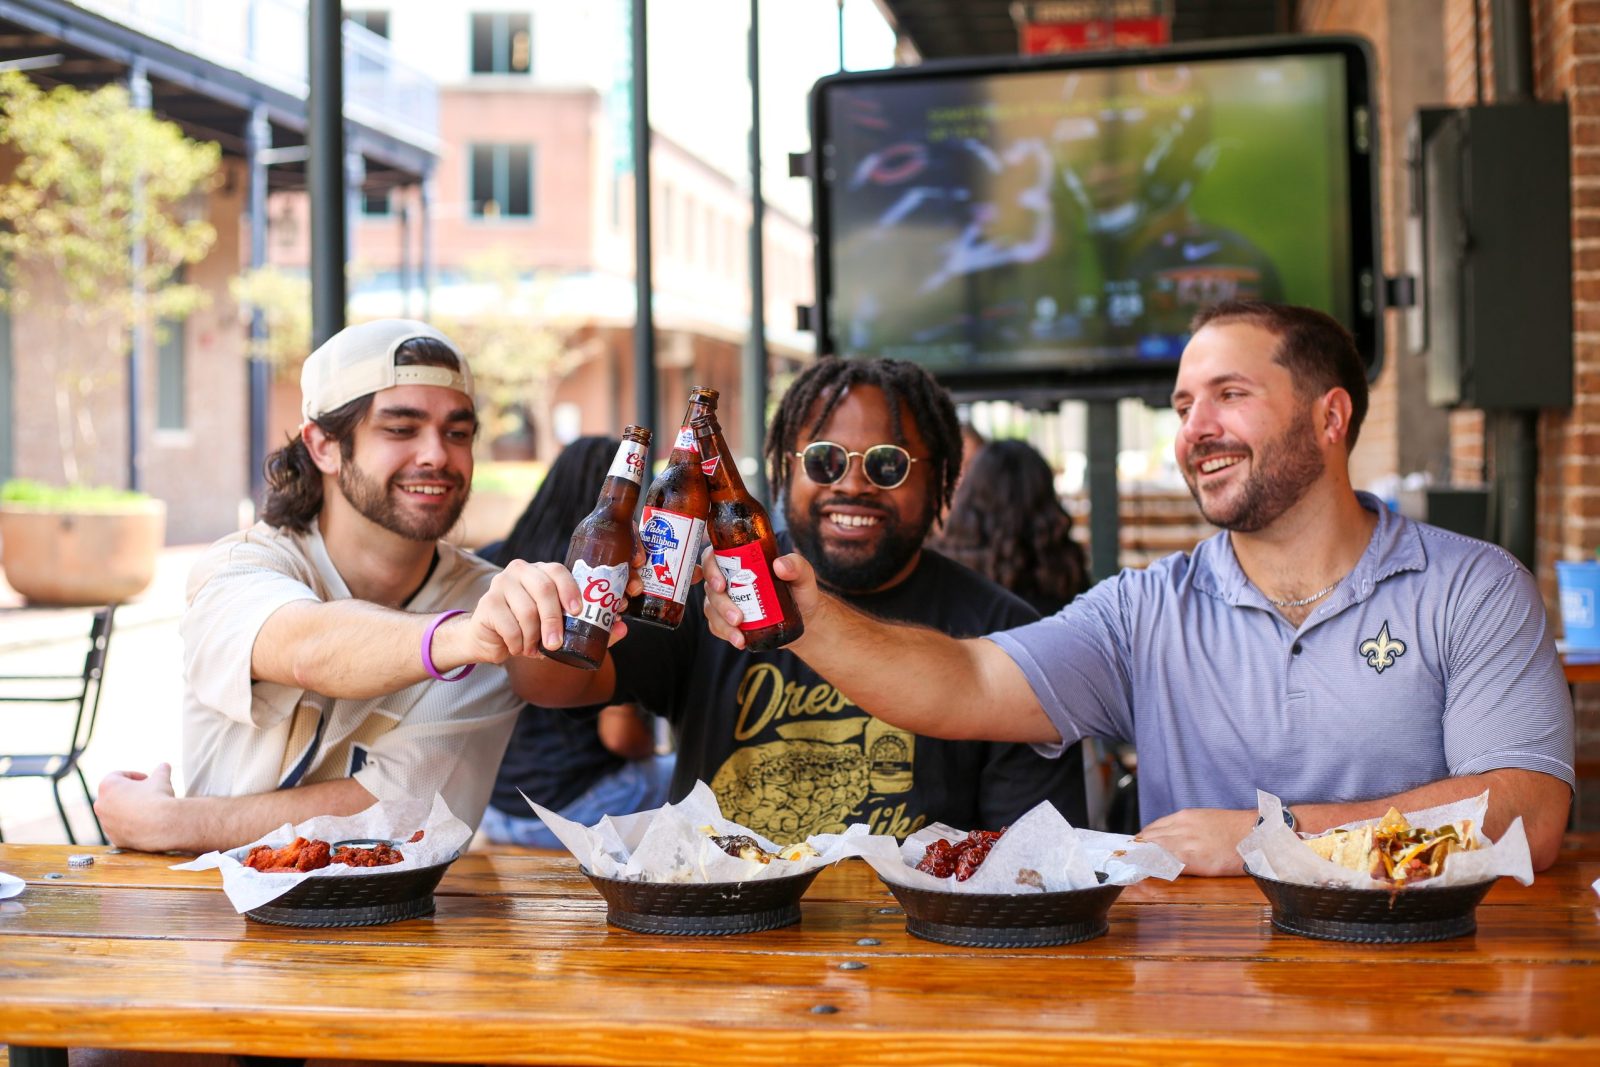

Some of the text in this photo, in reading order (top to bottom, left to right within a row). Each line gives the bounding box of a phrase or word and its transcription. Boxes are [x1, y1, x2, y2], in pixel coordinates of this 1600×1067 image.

[627, 465, 643, 478] LIG
[647, 520, 669, 536] Pabst
[650, 534, 677, 549] Ribbon
[753, 583, 768, 619] GENUINE
[584, 604, 614, 627] LIG
